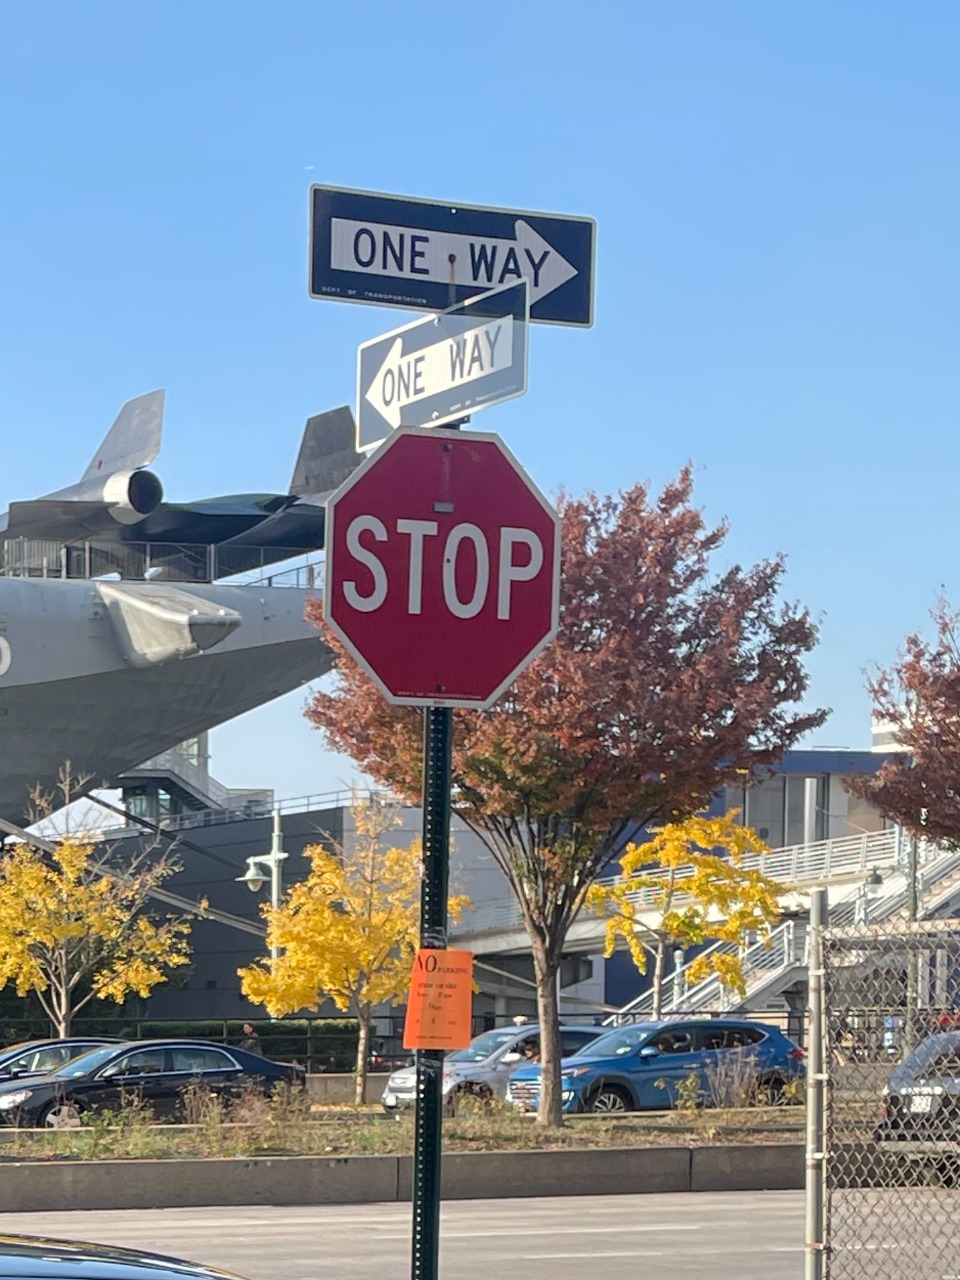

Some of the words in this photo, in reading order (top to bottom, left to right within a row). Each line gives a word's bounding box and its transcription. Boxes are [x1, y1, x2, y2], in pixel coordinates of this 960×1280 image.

[353, 228, 429, 275] ONE
[469, 242, 550, 288] WAY
[382, 355, 425, 407] ONE
[449, 325, 502, 382] WAY
[342, 514, 544, 620] STOP
